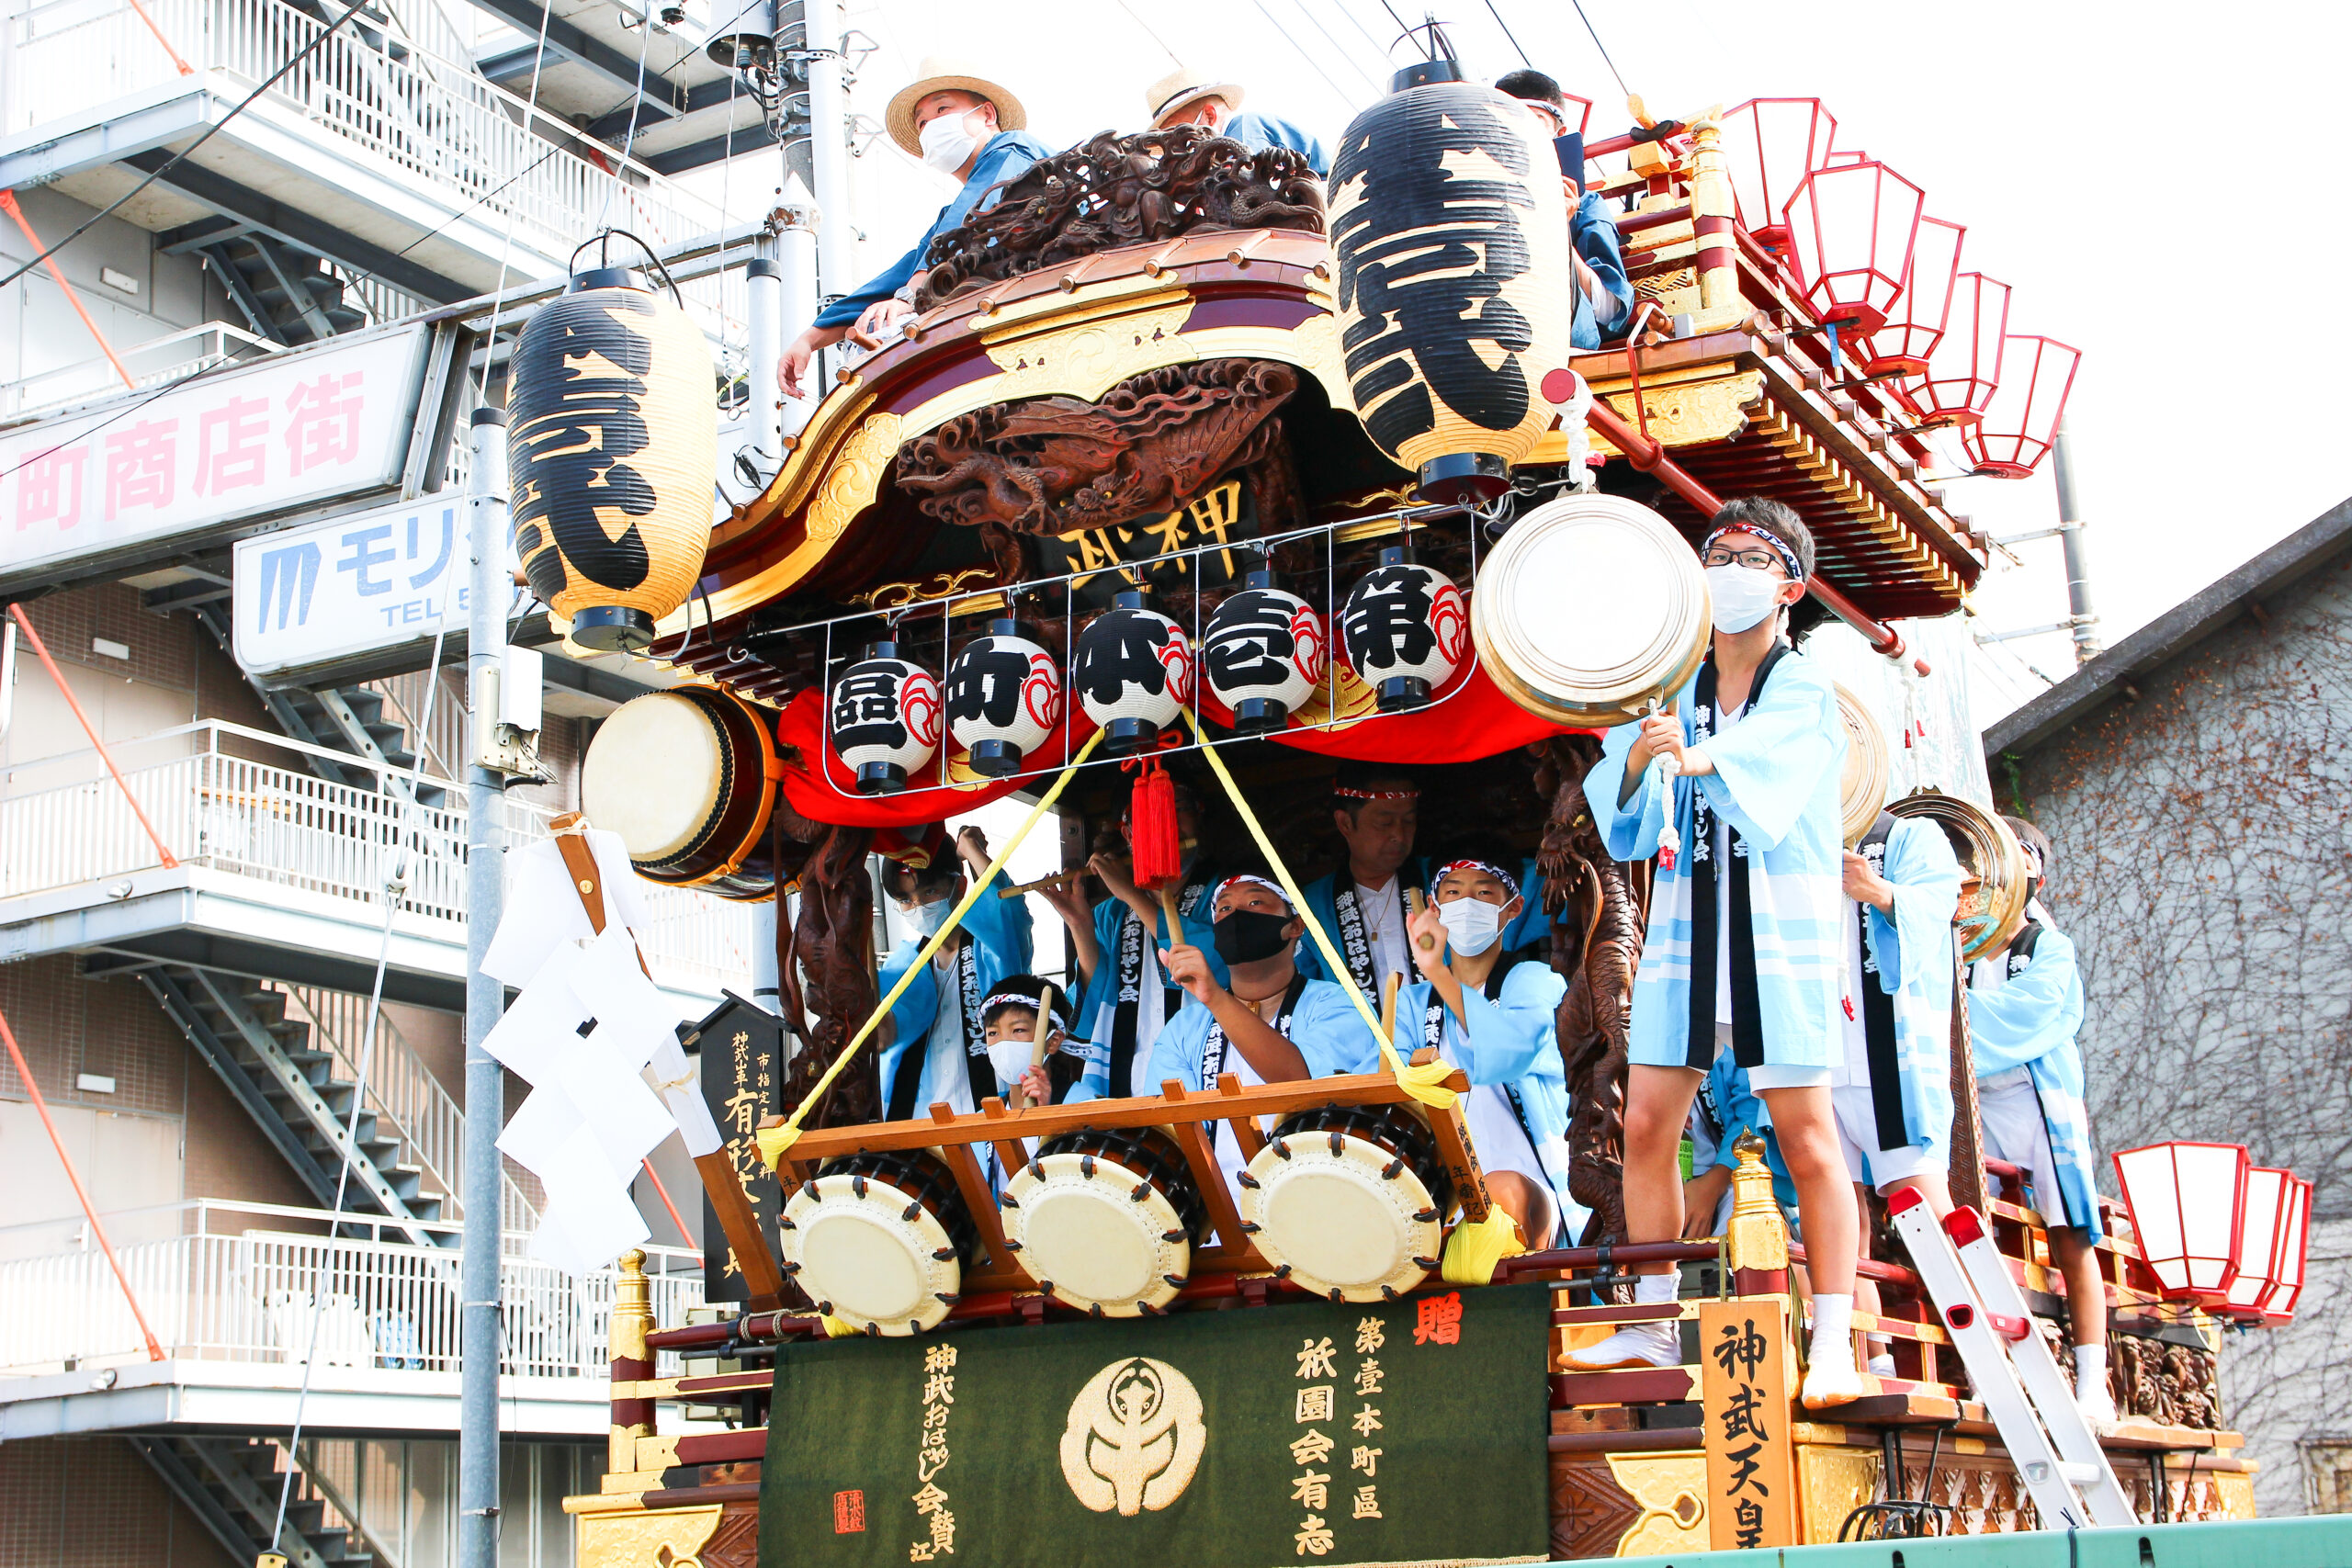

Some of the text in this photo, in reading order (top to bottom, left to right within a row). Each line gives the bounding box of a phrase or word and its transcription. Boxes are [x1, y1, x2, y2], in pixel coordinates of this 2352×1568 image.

[16, 369, 365, 532] 町商店街
[337, 503, 514, 597] モリ
[380, 598, 442, 626] TEL
[1413, 1291, 1464, 1346] 贈
[1713, 1318, 1770, 1550] 神武天皇
